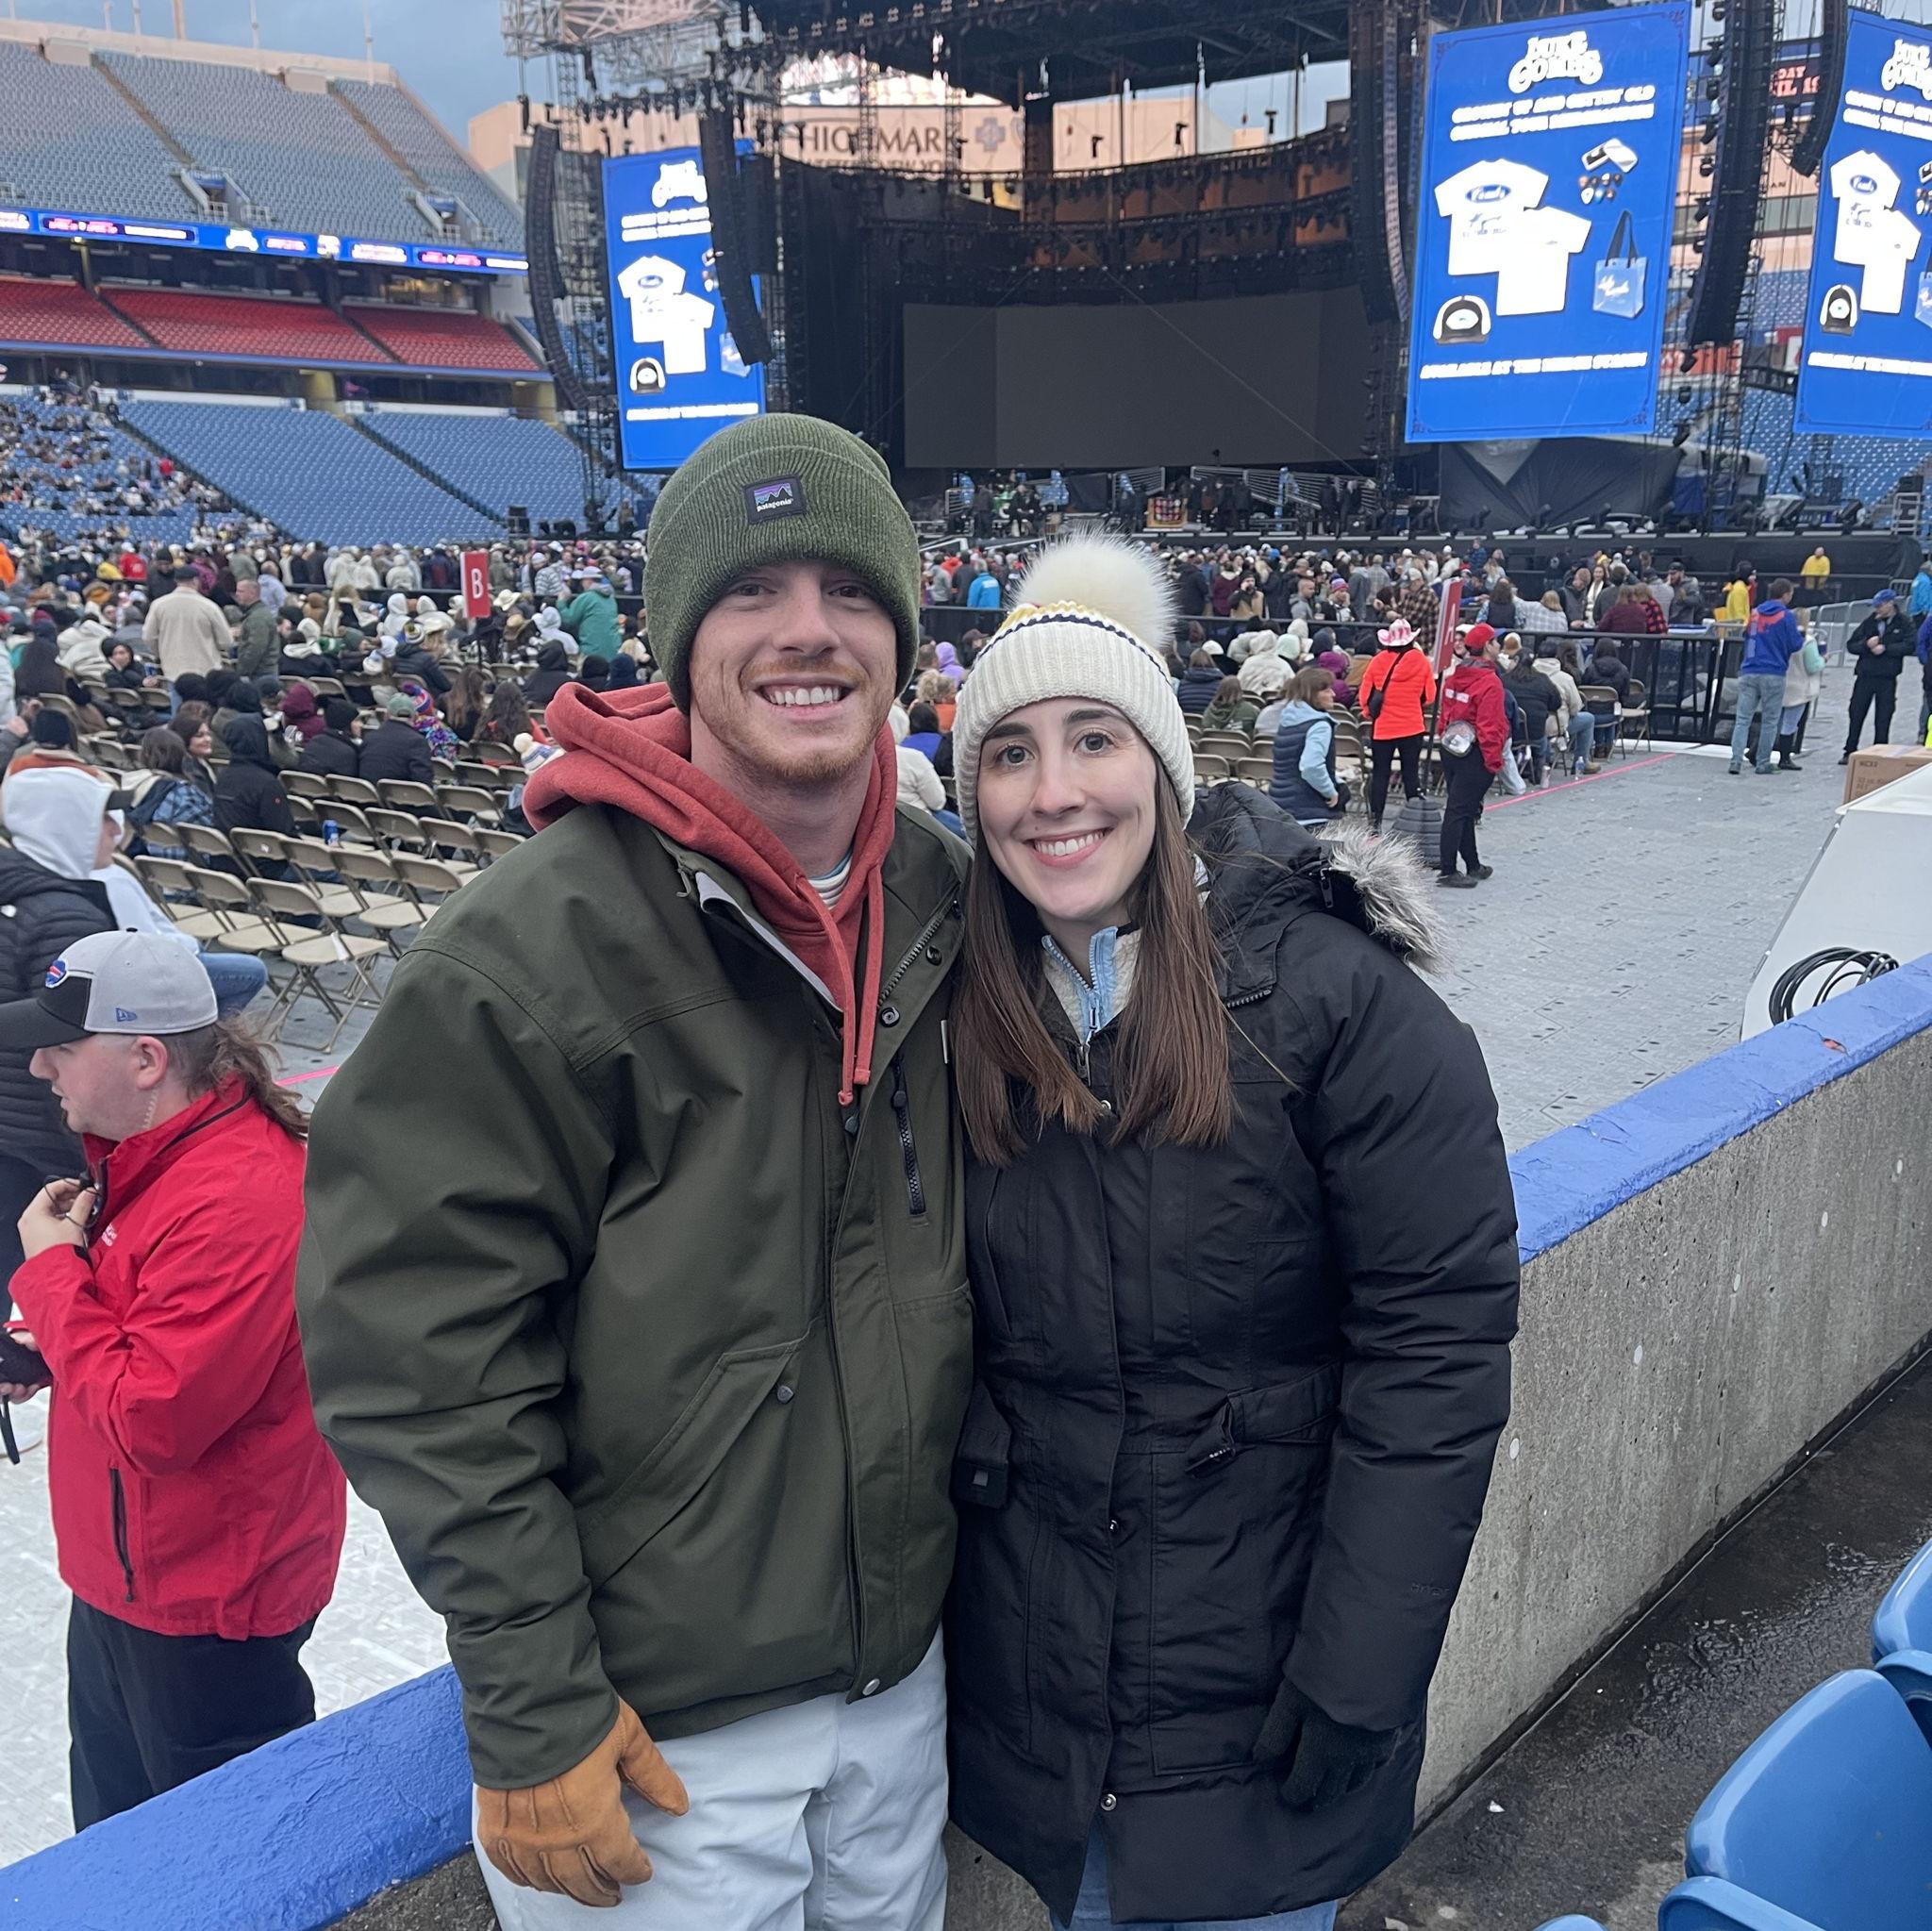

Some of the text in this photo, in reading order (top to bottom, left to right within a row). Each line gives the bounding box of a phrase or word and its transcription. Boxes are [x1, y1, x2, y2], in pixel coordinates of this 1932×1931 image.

[1527, 31, 1588, 58] LUKE
[757, 497, 792, 512] patagonia
[472, 568, 484, 599] B
